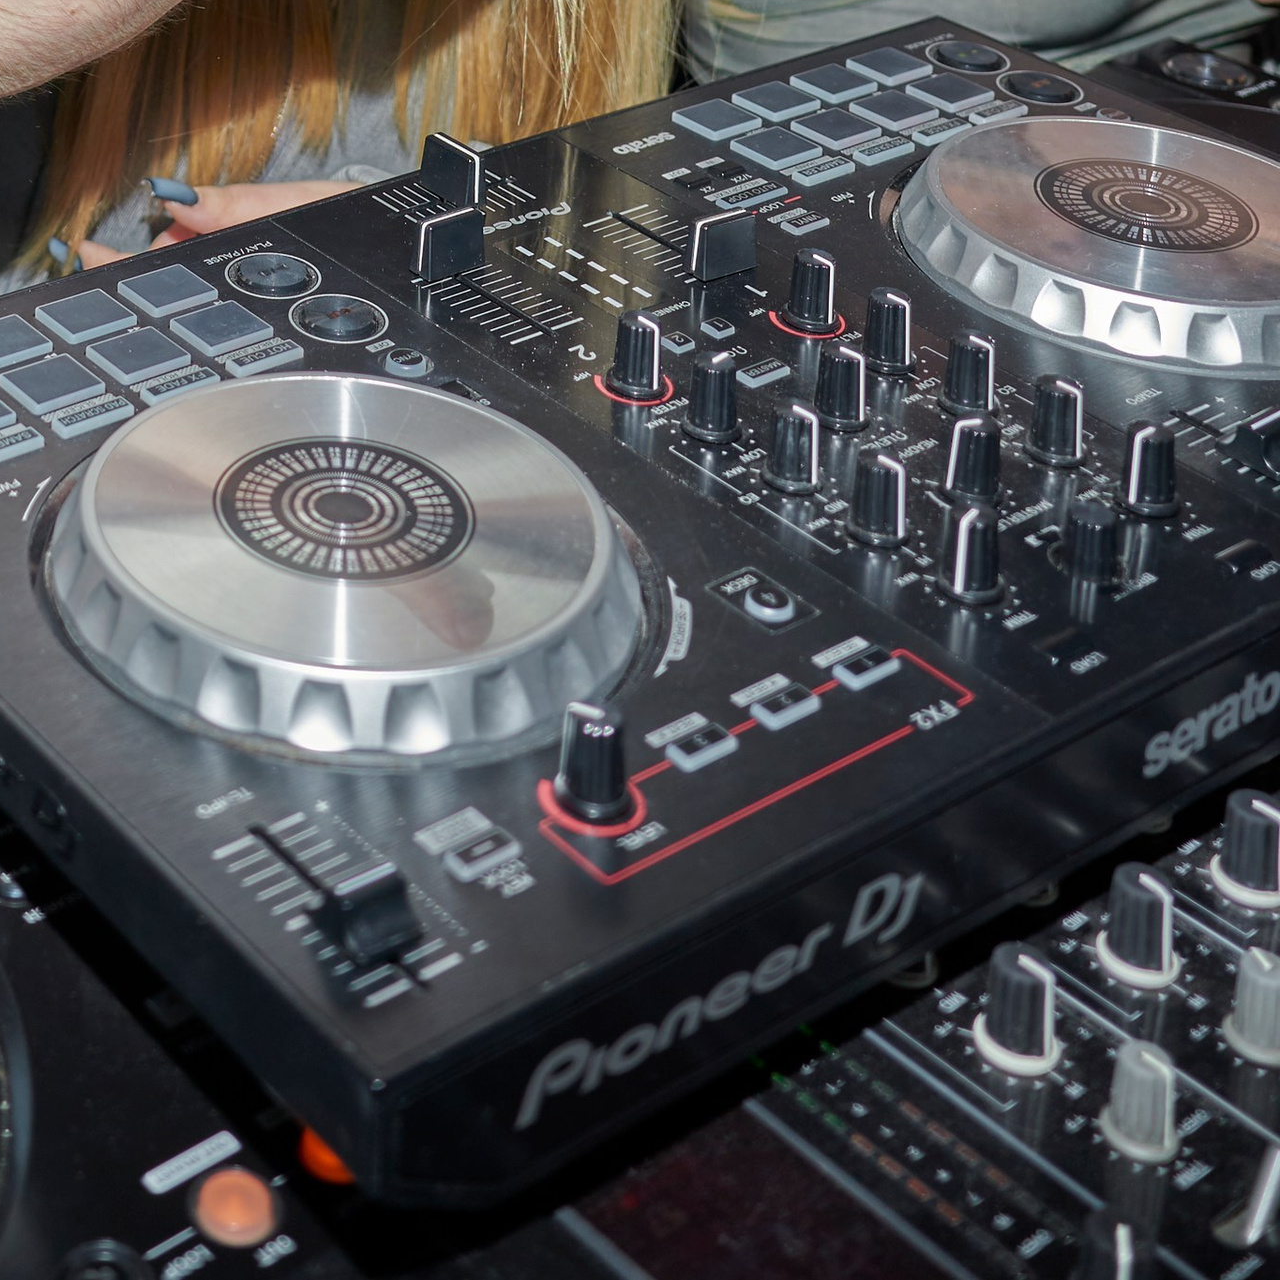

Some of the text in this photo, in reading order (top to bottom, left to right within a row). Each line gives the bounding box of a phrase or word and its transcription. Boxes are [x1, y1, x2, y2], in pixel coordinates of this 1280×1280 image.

[612, 131, 676, 156] serato
[801, 158, 846, 176] SAMPLER
[730, 172, 753, 184] 1/2X
[699, 185, 716, 194] 2X
[725, 182, 778, 204] AUTO LOOP
[759, 199, 786, 214] LOOP
[483, 201, 572, 235] Pionee
[791, 213, 822, 227] VINYL
[650, 299, 692, 318] CHANNEL
[747, 306, 767, 318] HPF
[370, 341, 390, 351] OFF
[671, 334, 685, 343] 2
[833, 329, 863, 345] FILT
[240, 342, 292, 365] HOT CUE
[392, 350, 421, 364] SYNC
[567, 343, 598, 362] 2
[571, 370, 593, 383] HPF
[744, 359, 782, 378] MASTER
[154, 371, 207, 394] FX FADE
[914, 376, 941, 392] LOW
[995, 383, 1017, 397] EQ
[900, 391, 924, 406] MAX
[1125, 387, 1163, 406] TEMPO
[59, 397, 126, 426] PAD SCRATCH
[61, 399, 96, 417] SLICER
[650, 396, 690, 416] FILTER
[644, 416, 668, 430] MAX
[1001, 422, 1025, 437] MID
[738, 447, 768, 464] LOW
[721, 464, 747, 480] MAX
[737, 492, 761, 506] EQ
[1075, 487, 1101, 502] MAX
[823, 499, 850, 515] MID
[1006, 499, 1055, 525] MASTER
[804, 516, 831, 533] MAX
[1181, 523, 1215, 542] TRIM
[1250, 560, 1280, 581] LOAD
[719, 573, 760, 596] DECK
[1112, 572, 1159, 602] BRO
[1001, 610, 1039, 631] TRIM
[1069, 651, 1109, 675] LOAD
[908, 699, 961, 731] FX2
[1142, 671, 1280, 779] serato
[194, 786, 256, 819] TEMPO
[512, 871, 927, 1131] Pioneer DJ
[253, 1235, 297, 1268] OUT
